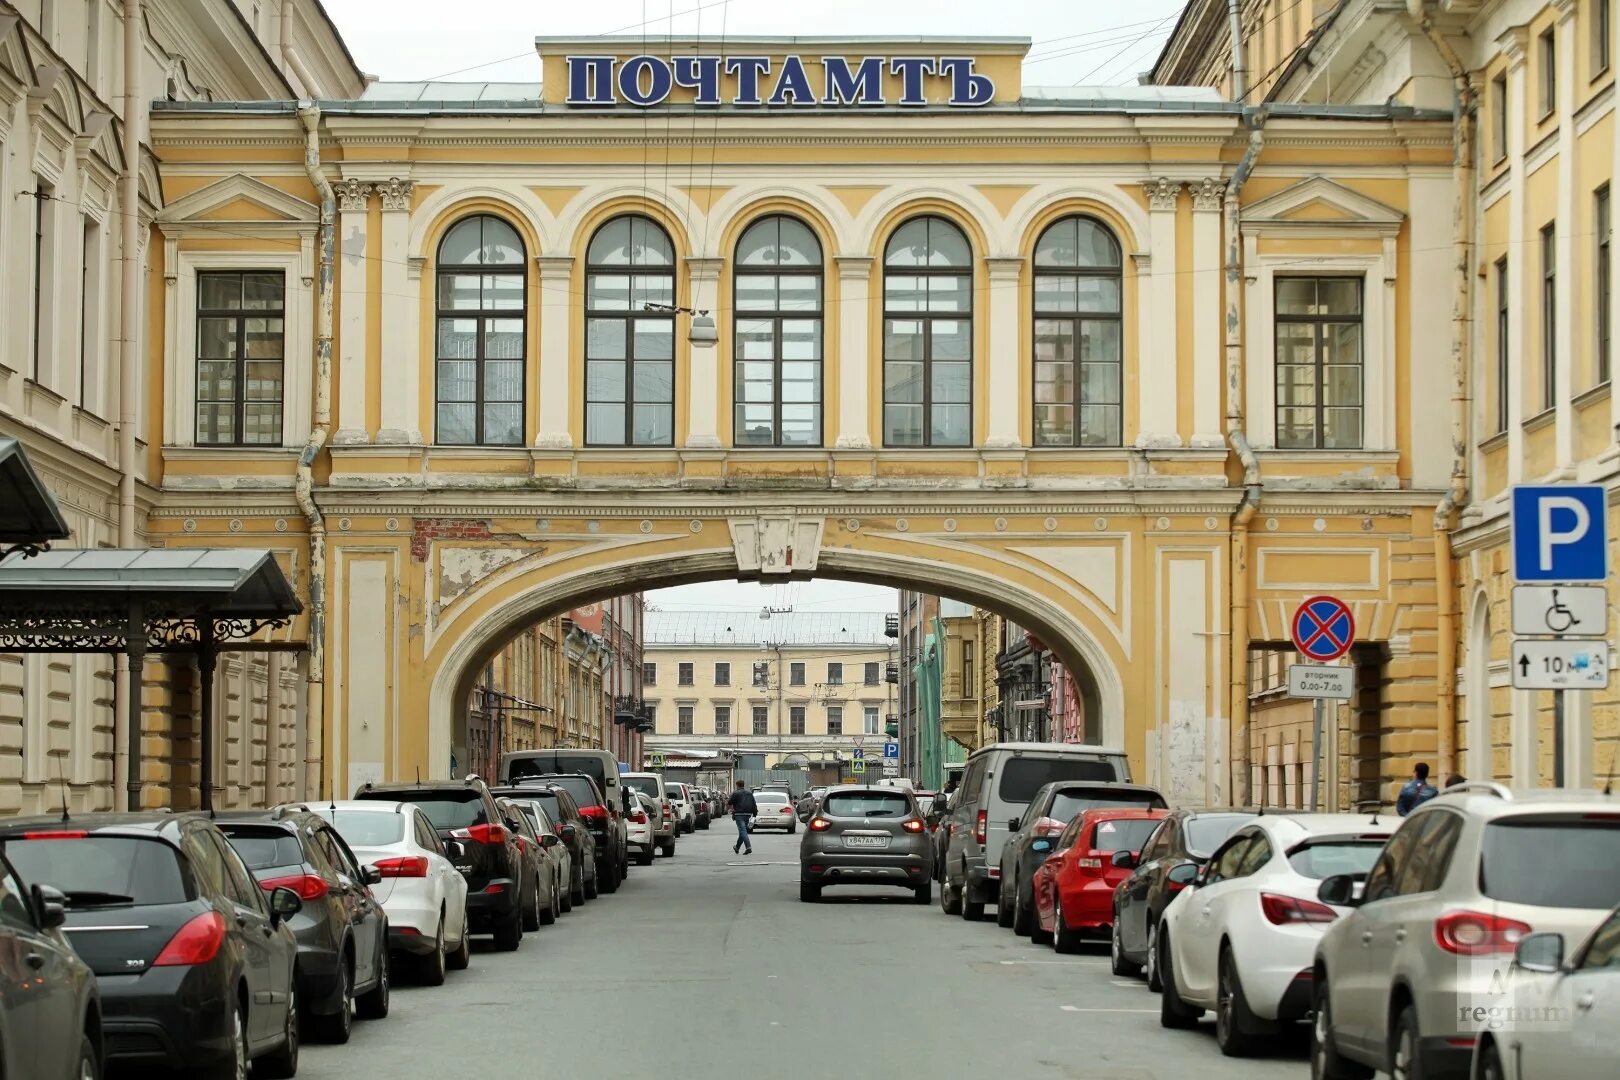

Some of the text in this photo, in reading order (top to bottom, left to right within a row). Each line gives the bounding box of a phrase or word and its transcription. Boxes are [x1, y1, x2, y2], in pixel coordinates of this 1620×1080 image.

[565, 54, 995, 106] ПОЧТАМТЪ
[1538, 496, 1590, 571] P
[1543, 656, 1563, 673] 10
[1304, 672, 1339, 680] вторник
[1300, 681, 1343, 692] 0.00-7.00
[887, 744, 897, 757] P
